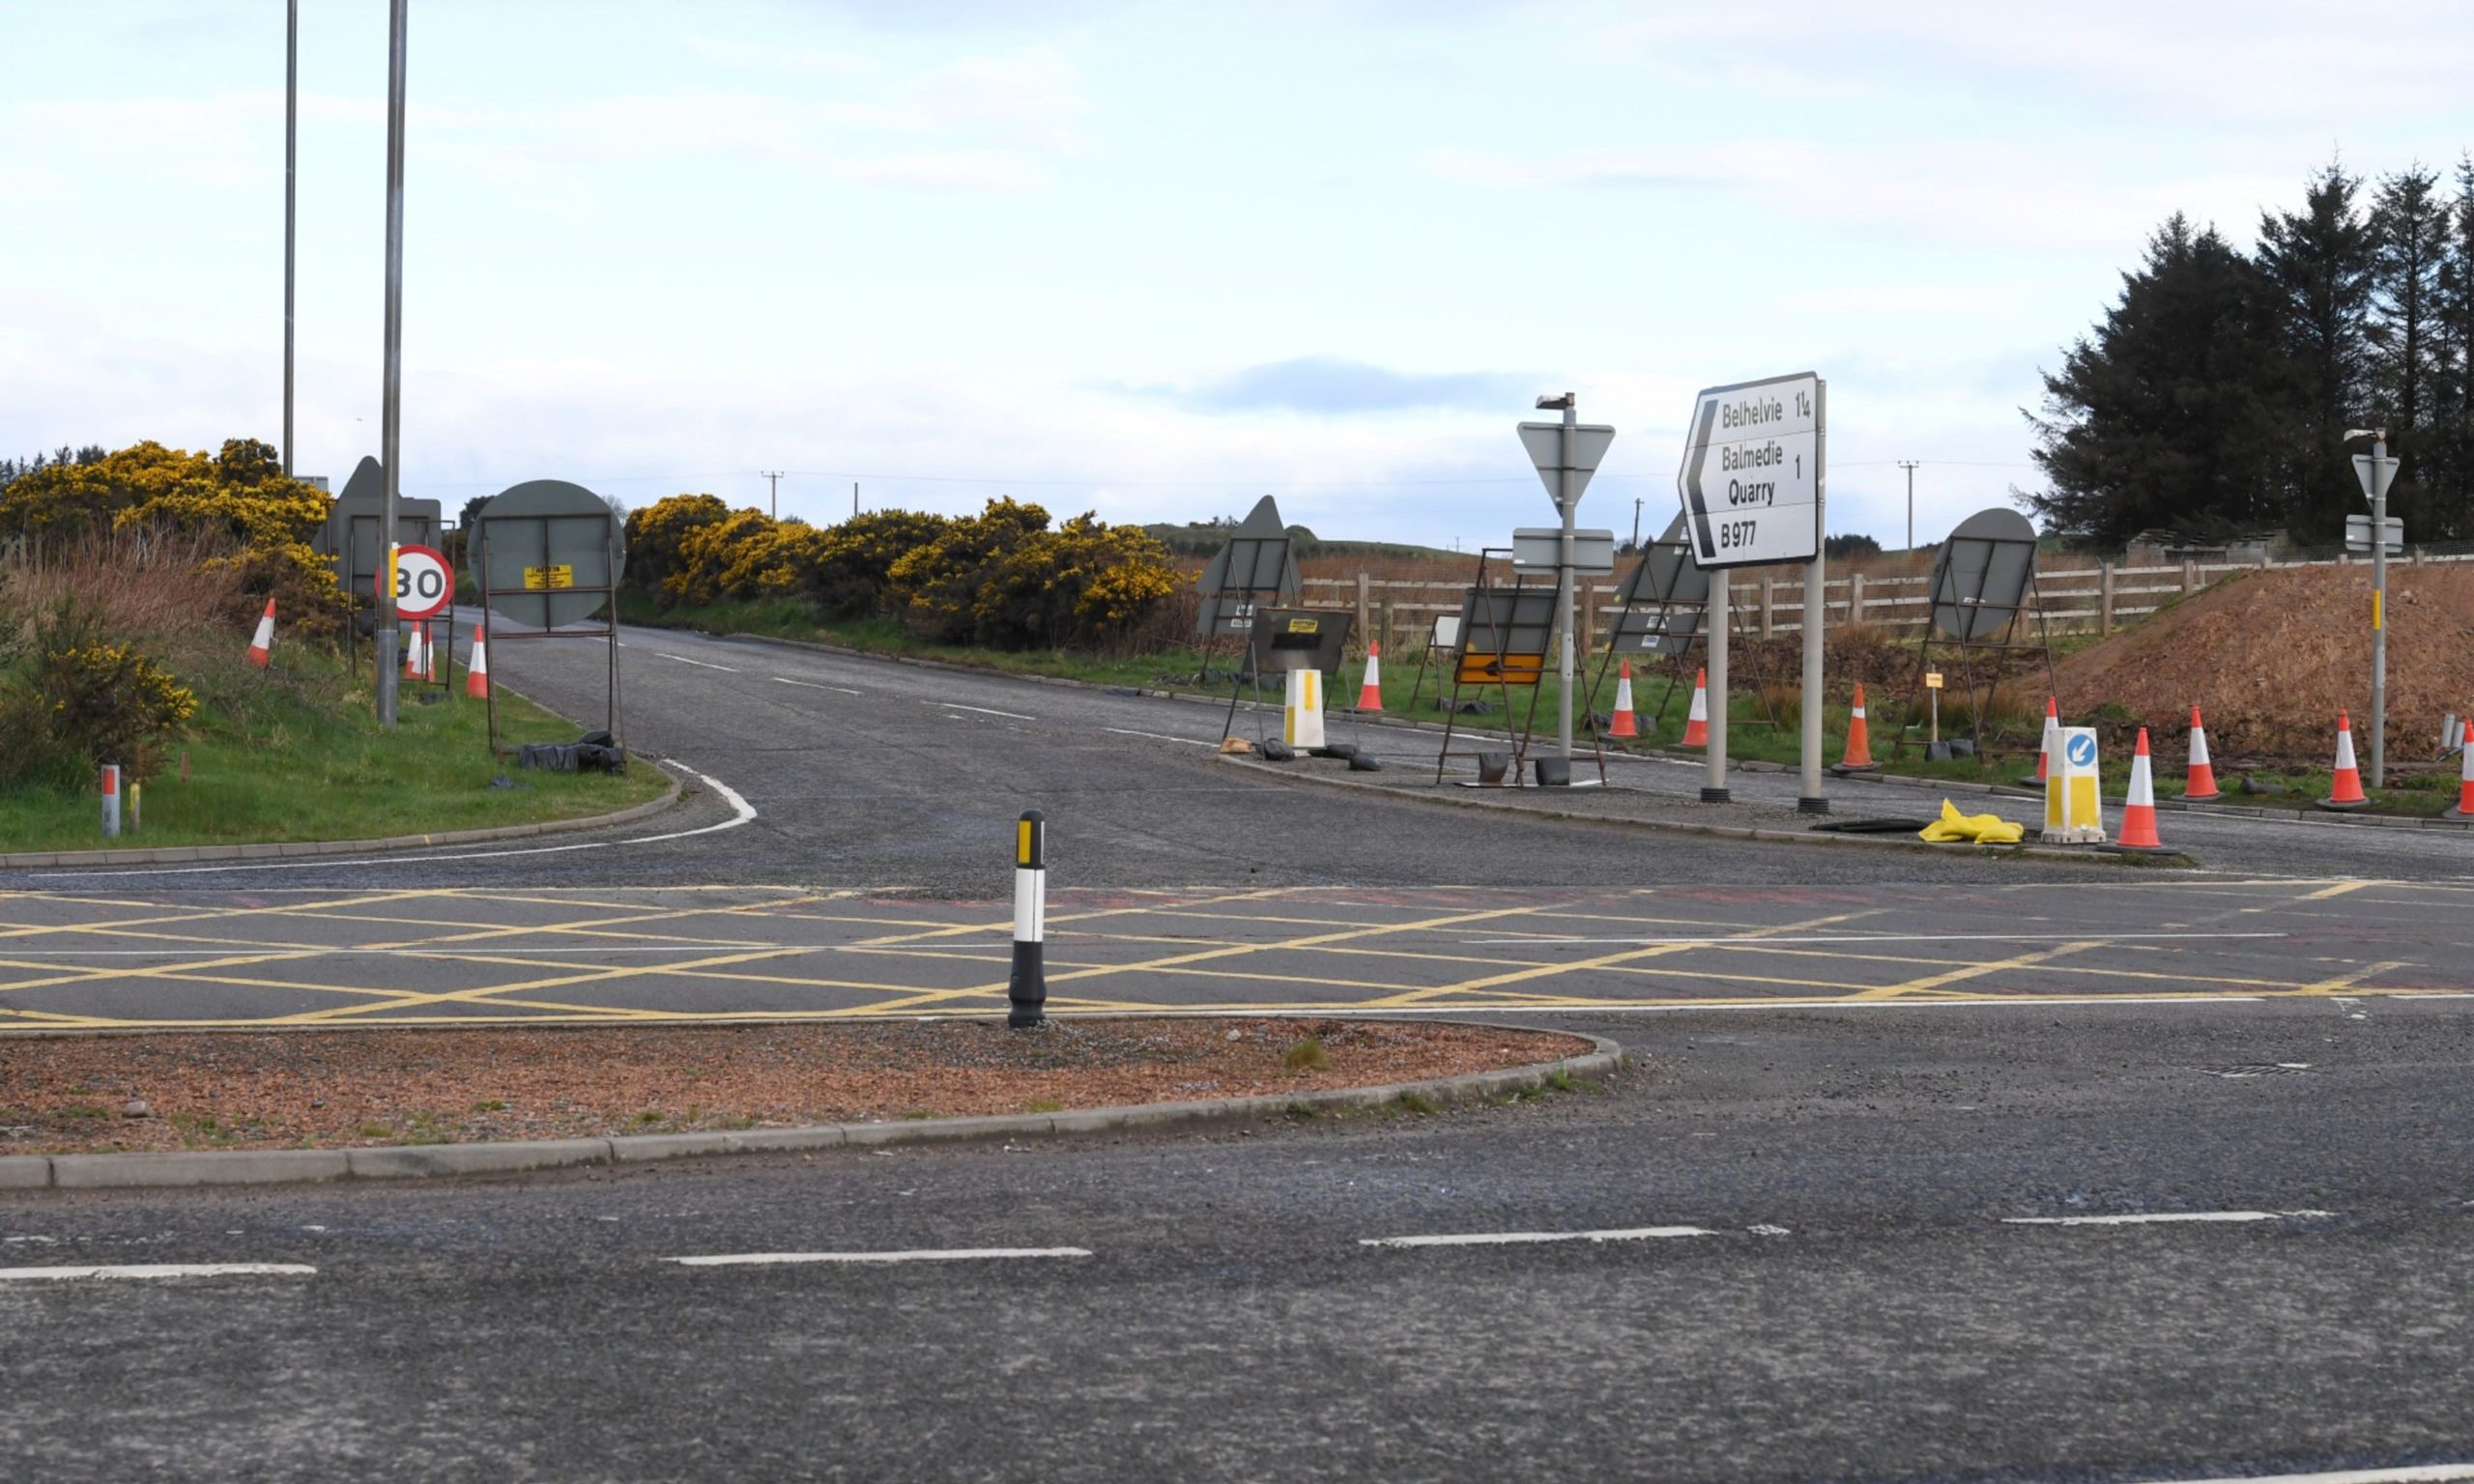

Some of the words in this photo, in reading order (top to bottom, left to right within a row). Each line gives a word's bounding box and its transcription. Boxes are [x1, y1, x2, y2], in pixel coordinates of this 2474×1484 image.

[1723, 397, 1782, 428] Belhelvie
[1722, 441, 1782, 471] Balmedie
[1796, 454, 1800, 479] 1
[1729, 479, 1774, 506] Quarry
[1721, 521, 1756, 548] B977
